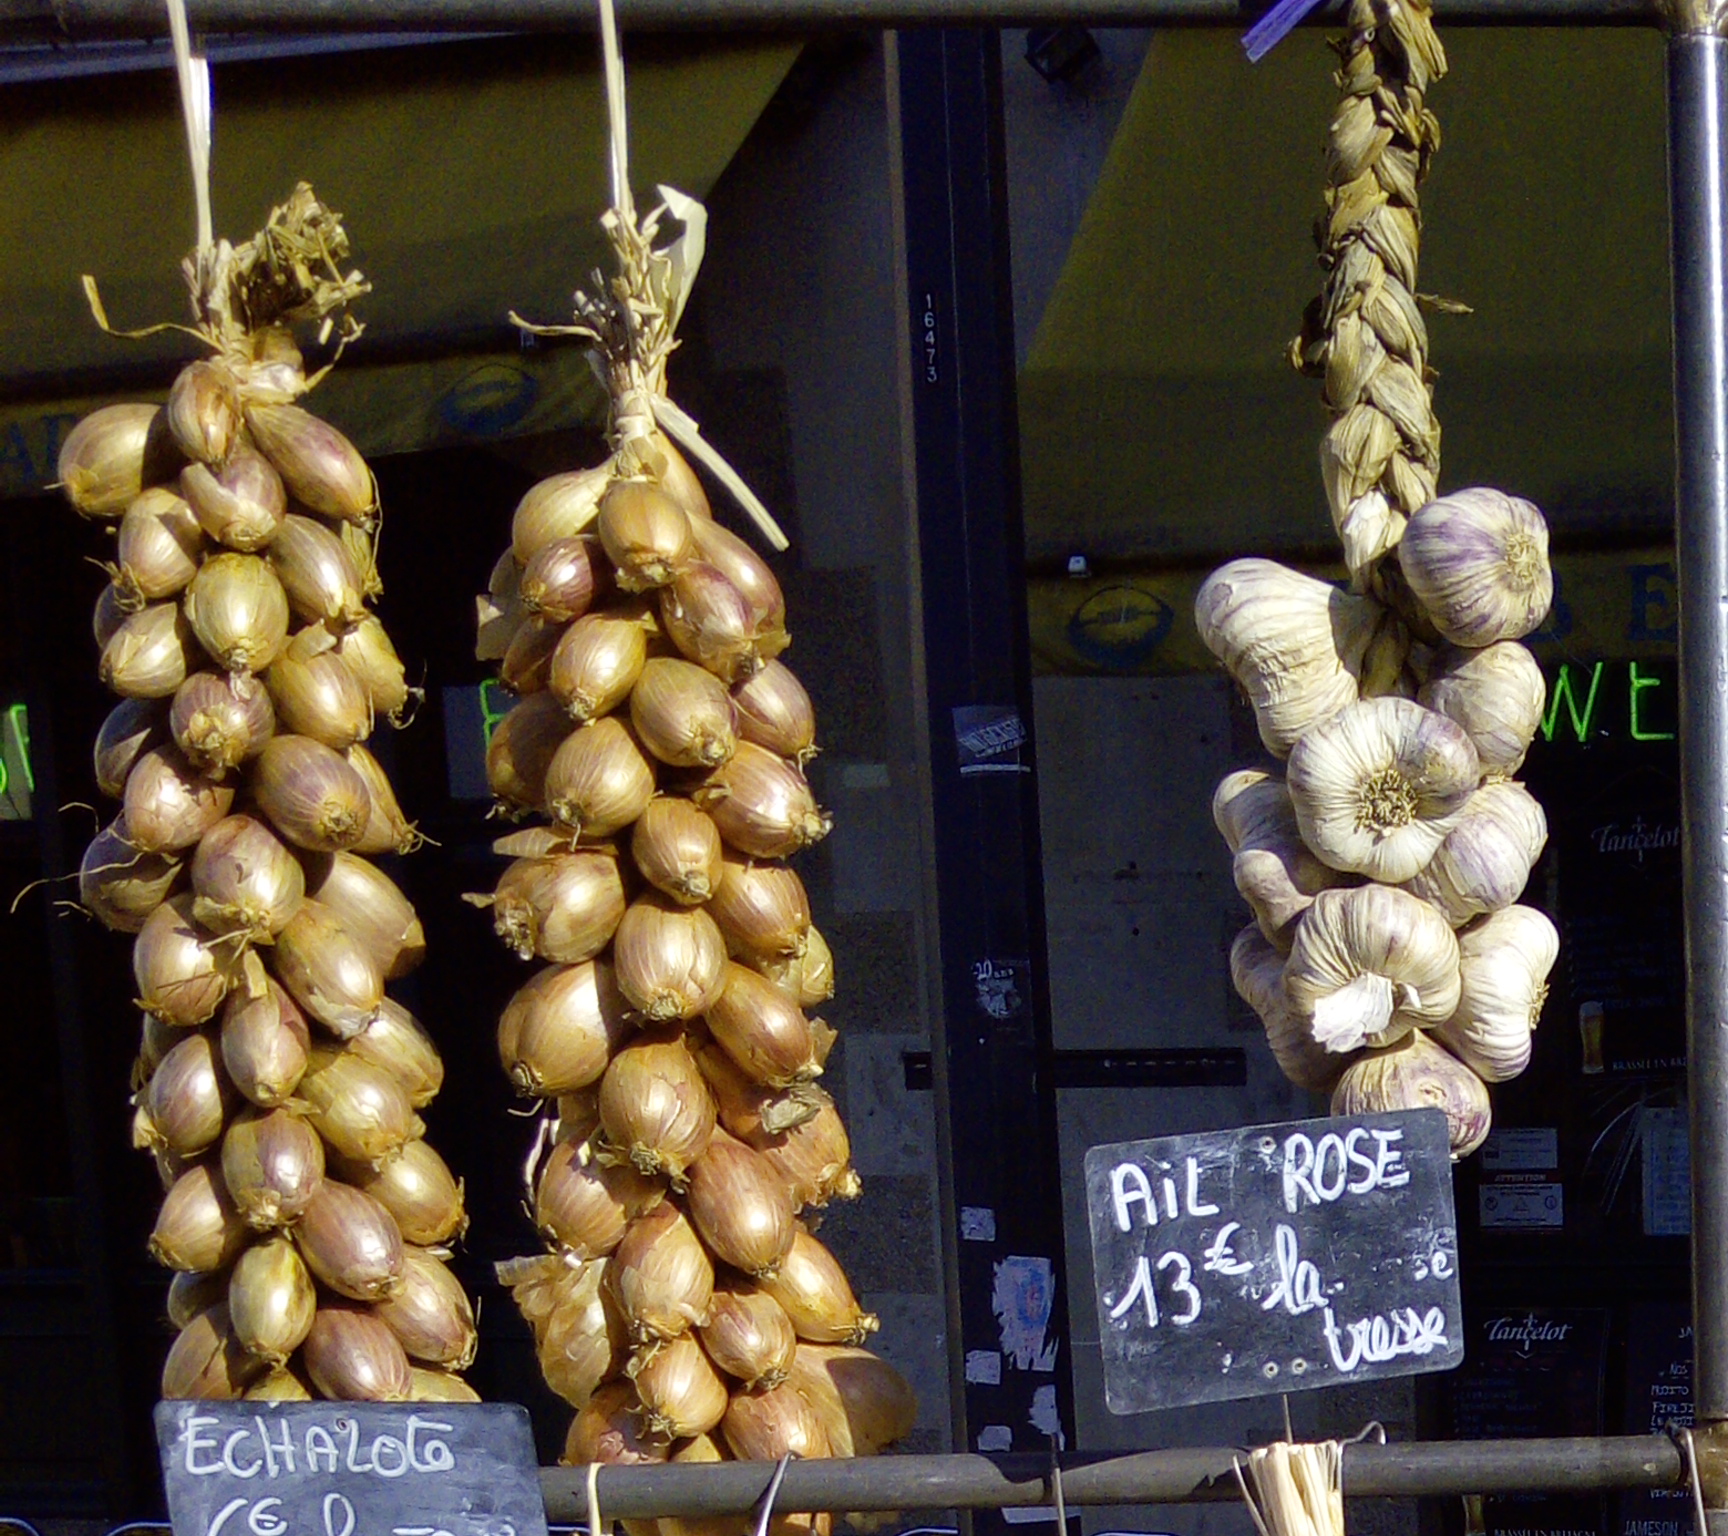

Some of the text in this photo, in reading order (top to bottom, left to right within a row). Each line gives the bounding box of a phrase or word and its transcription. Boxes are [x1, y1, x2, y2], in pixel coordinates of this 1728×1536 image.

[923, 293, 938, 383] 16473
[1283, 1127, 1411, 1213] ROSE
[1262, 1224, 1329, 1315] la
